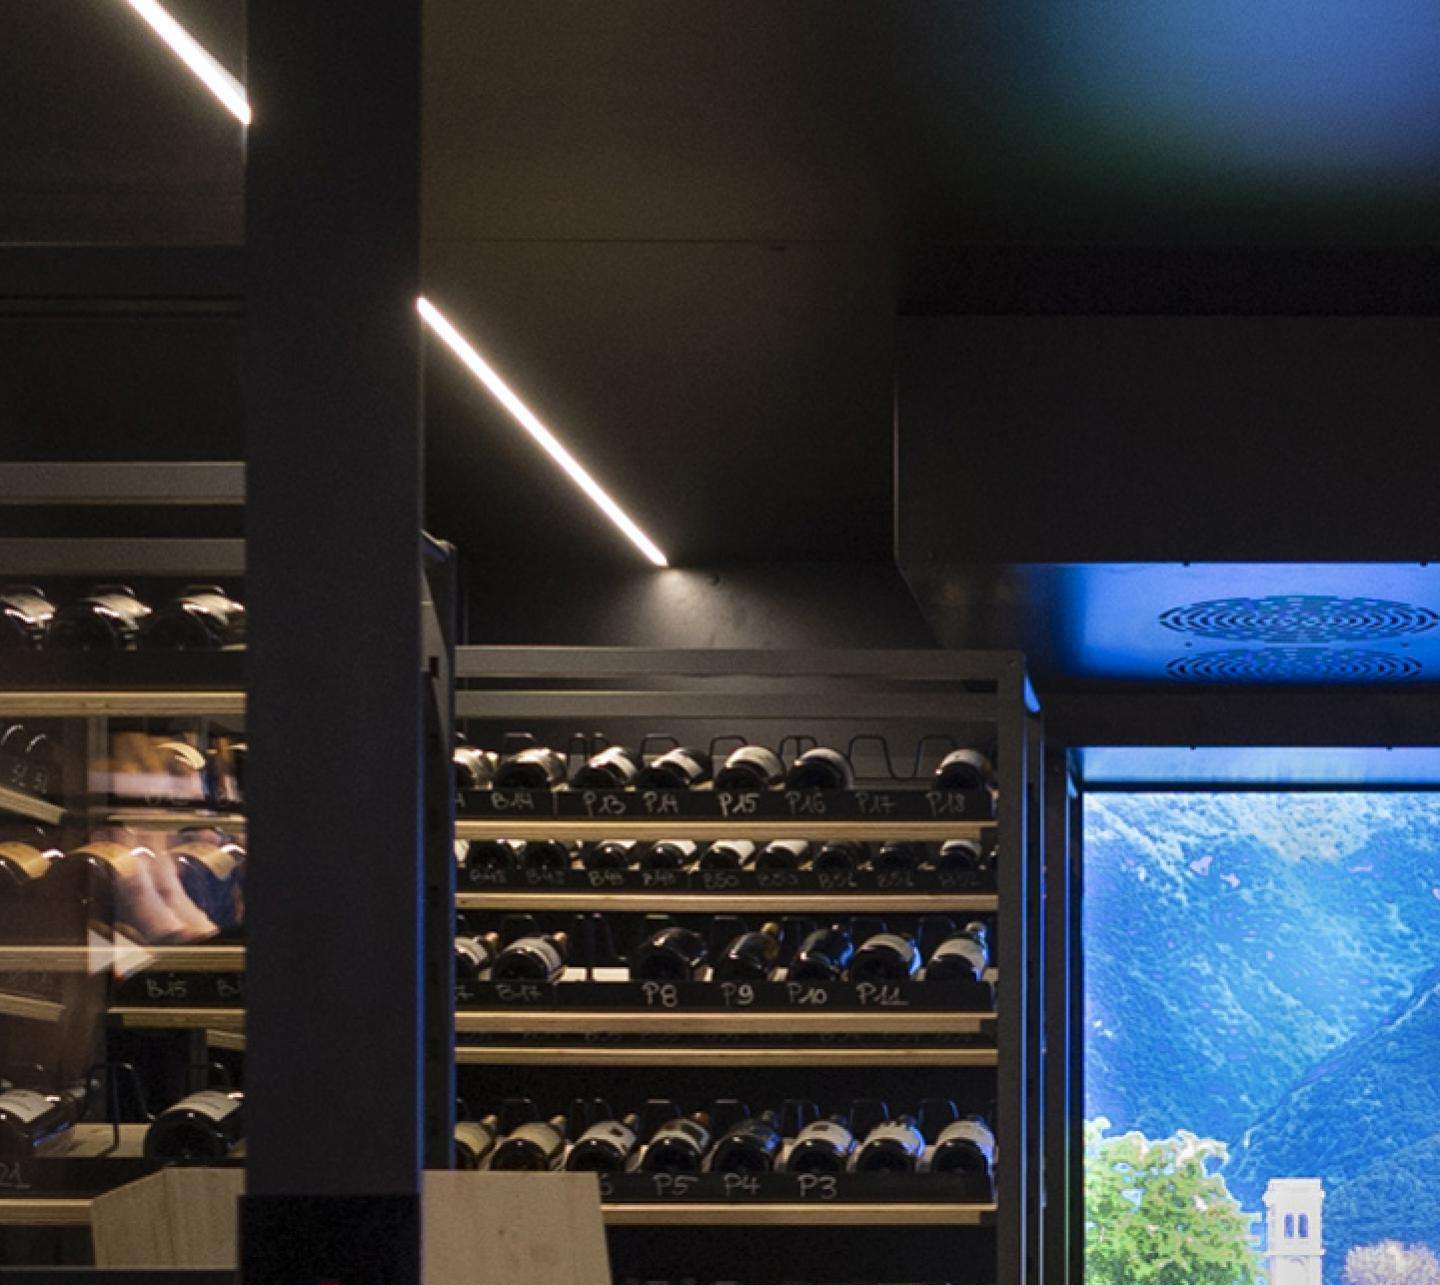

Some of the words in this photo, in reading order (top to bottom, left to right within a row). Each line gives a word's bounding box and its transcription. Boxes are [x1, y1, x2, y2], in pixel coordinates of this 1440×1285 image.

[642, 982, 679, 1007] P8
[721, 982, 754, 1005] P9
[652, 1174, 699, 1197] P5
[723, 1174, 760, 1196] P4
[798, 1175, 837, 1199] P3
